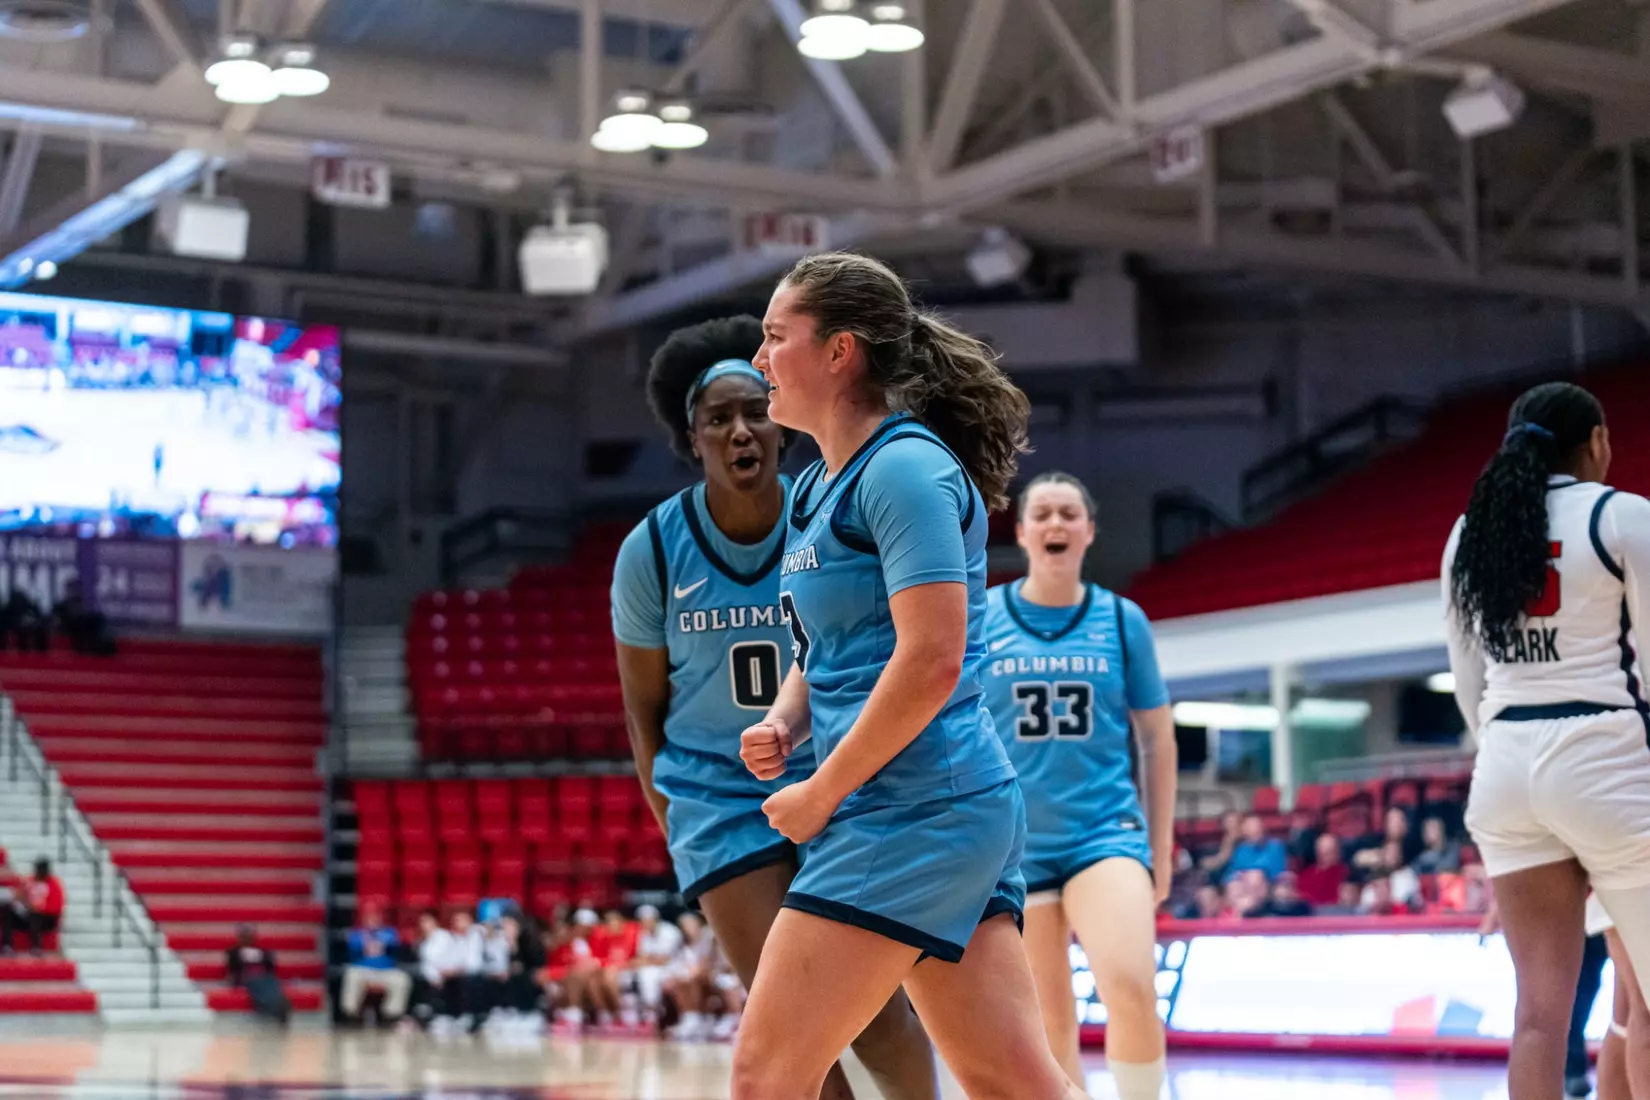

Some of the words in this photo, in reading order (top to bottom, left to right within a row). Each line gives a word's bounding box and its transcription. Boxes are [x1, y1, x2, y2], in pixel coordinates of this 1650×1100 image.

[729, 640, 781, 710] 0
[991, 656, 1110, 677] COLUMBIA
[1012, 681, 1094, 741] 33
